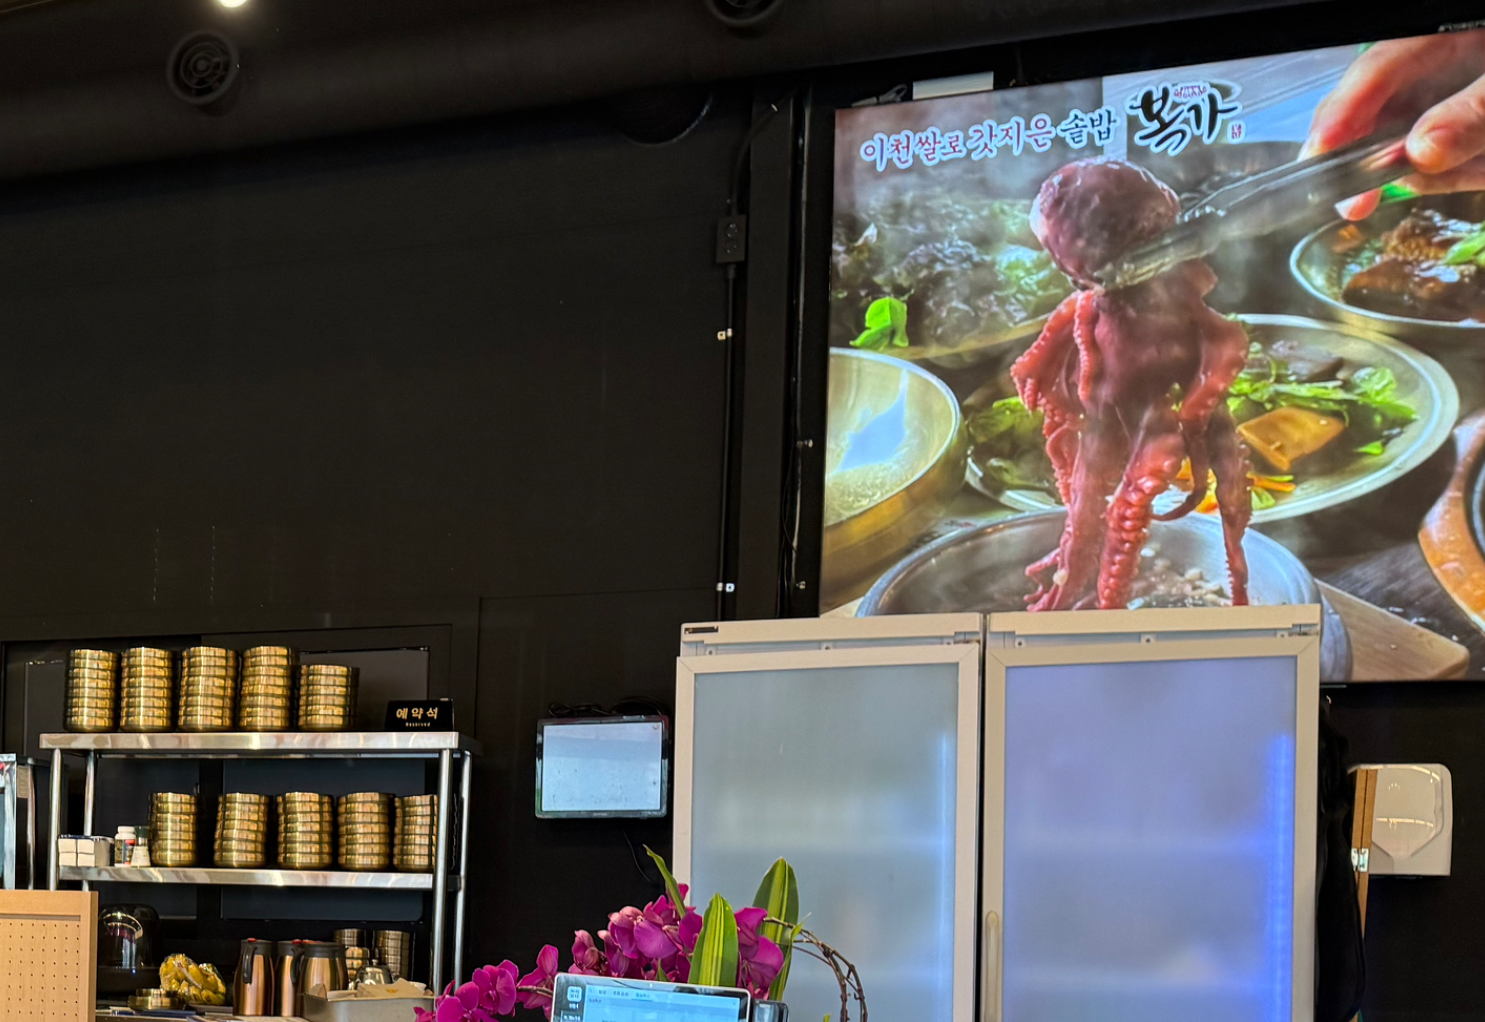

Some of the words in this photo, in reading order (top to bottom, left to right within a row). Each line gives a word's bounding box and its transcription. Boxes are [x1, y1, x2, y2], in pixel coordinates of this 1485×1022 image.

[862, 130, 965, 169] 이천쌀로
[969, 117, 1055, 158] 갓지은
[1128, 85, 1239, 153] 복가
[396, 706, 439, 720] 예약석
